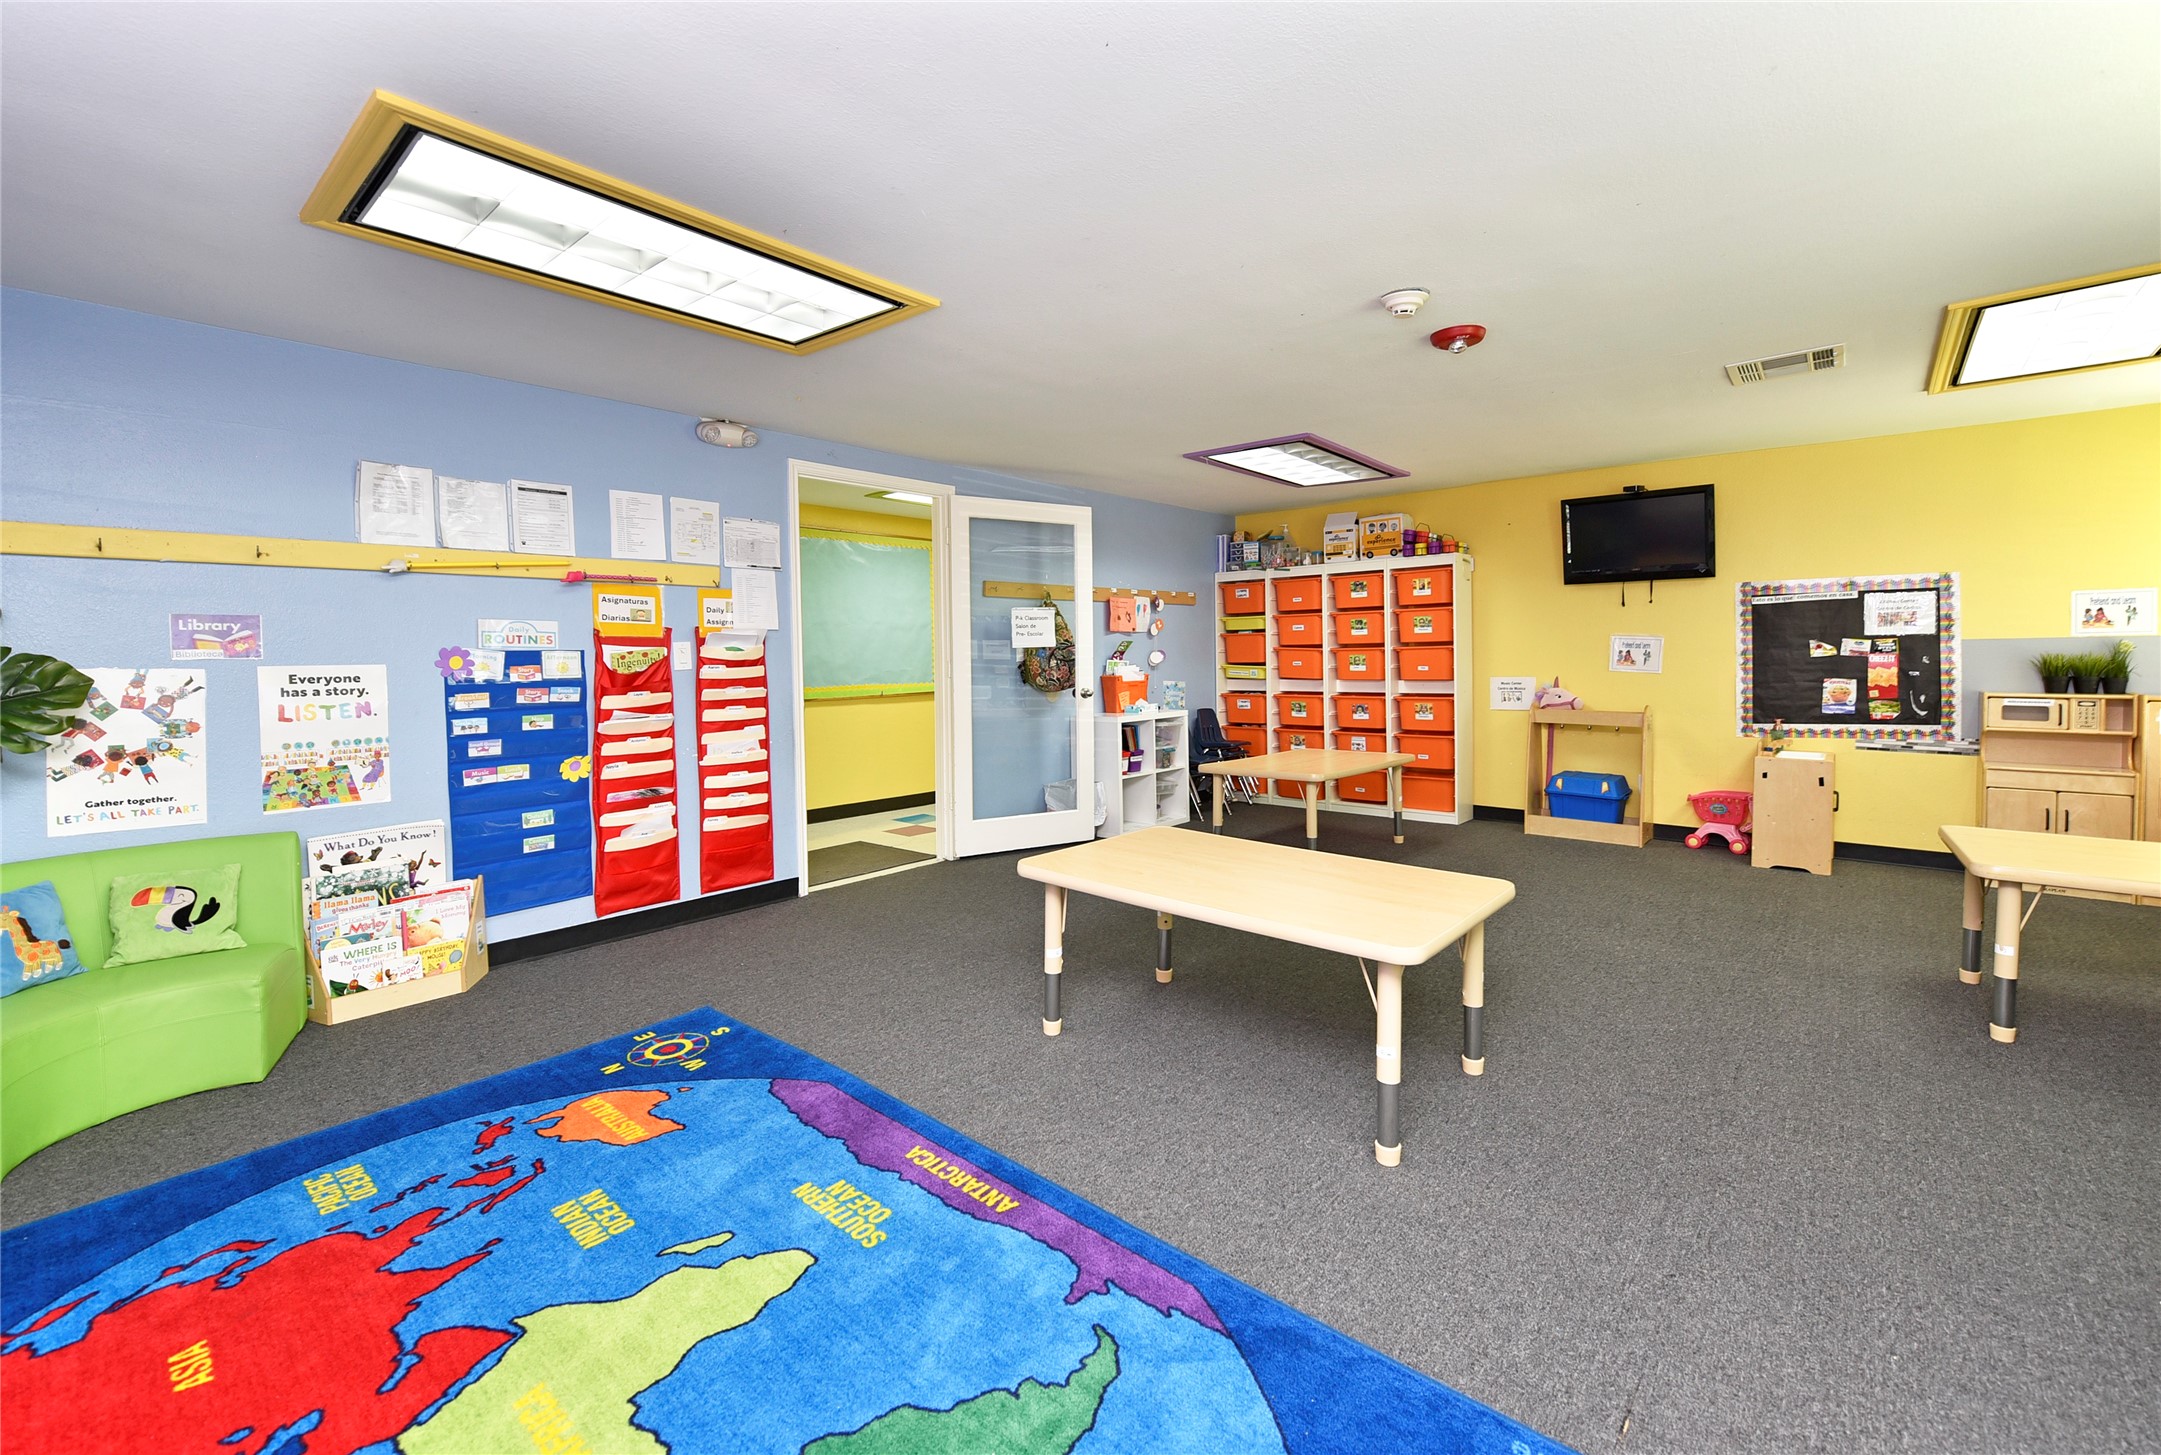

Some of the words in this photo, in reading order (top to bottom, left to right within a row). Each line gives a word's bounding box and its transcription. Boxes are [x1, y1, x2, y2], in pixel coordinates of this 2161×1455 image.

[1367, 537, 1396, 545] experience
[601, 595, 649, 606] Asignaturas
[706, 606, 724, 615] Daily
[601, 614, 631, 622] Diarias
[178, 619, 241, 634] Library
[509, 626, 529, 634] Daily
[484, 634, 553, 645] ROUTINES
[175, 650, 223, 658] Biblioteca
[471, 652, 497, 661] orning
[288, 674, 361, 686] Everyone
[281, 687, 308, 698] has
[312, 689, 321, 697] a
[325, 687, 369, 698] story.
[277, 701, 378, 723] LISTEN.
[85, 799, 123, 808] Gather
[127, 796, 177, 807] together.
[56, 812, 94, 825] LET'S
[100, 811, 126, 822] ALL
[130, 806, 162, 818] TAKE
[168, 804, 200, 815] PART.
[324, 841, 355, 852] What
[358, 838, 375, 848] Do
[378, 835, 398, 845] You
[401, 829, 437, 841] Know!
[324, 899, 348, 909] llama
[352, 895, 375, 903] llama
[332, 906, 348, 915] gives
[349, 902, 369, 911] thanks
[349, 918, 388, 935] Marley
[343, 945, 384, 959] WHERE
[387, 942, 397, 951] IS
[372, 951, 397, 960] Hungry
[352, 959, 384, 971] Caterpil
[633, 1031, 657, 1042] E
[710, 1026, 730, 1036] S
[600, 1062, 625, 1075] N
[680, 1058, 707, 1072] W
[581, 1096, 650, 1141] AUSTRALIA
[335, 1163, 378, 1202] OCEAN
[904, 1145, 1021, 1214] ANTARCTICA
[303, 1172, 350, 1215] PACIFIC
[826, 1179, 893, 1225] OCEAN
[578, 1188, 636, 1235] OCEAN
[790, 1181, 888, 1249] SOUTHERN
[551, 1199, 610, 1250] INDIAN
[167, 1339, 215, 1393] ASIA
